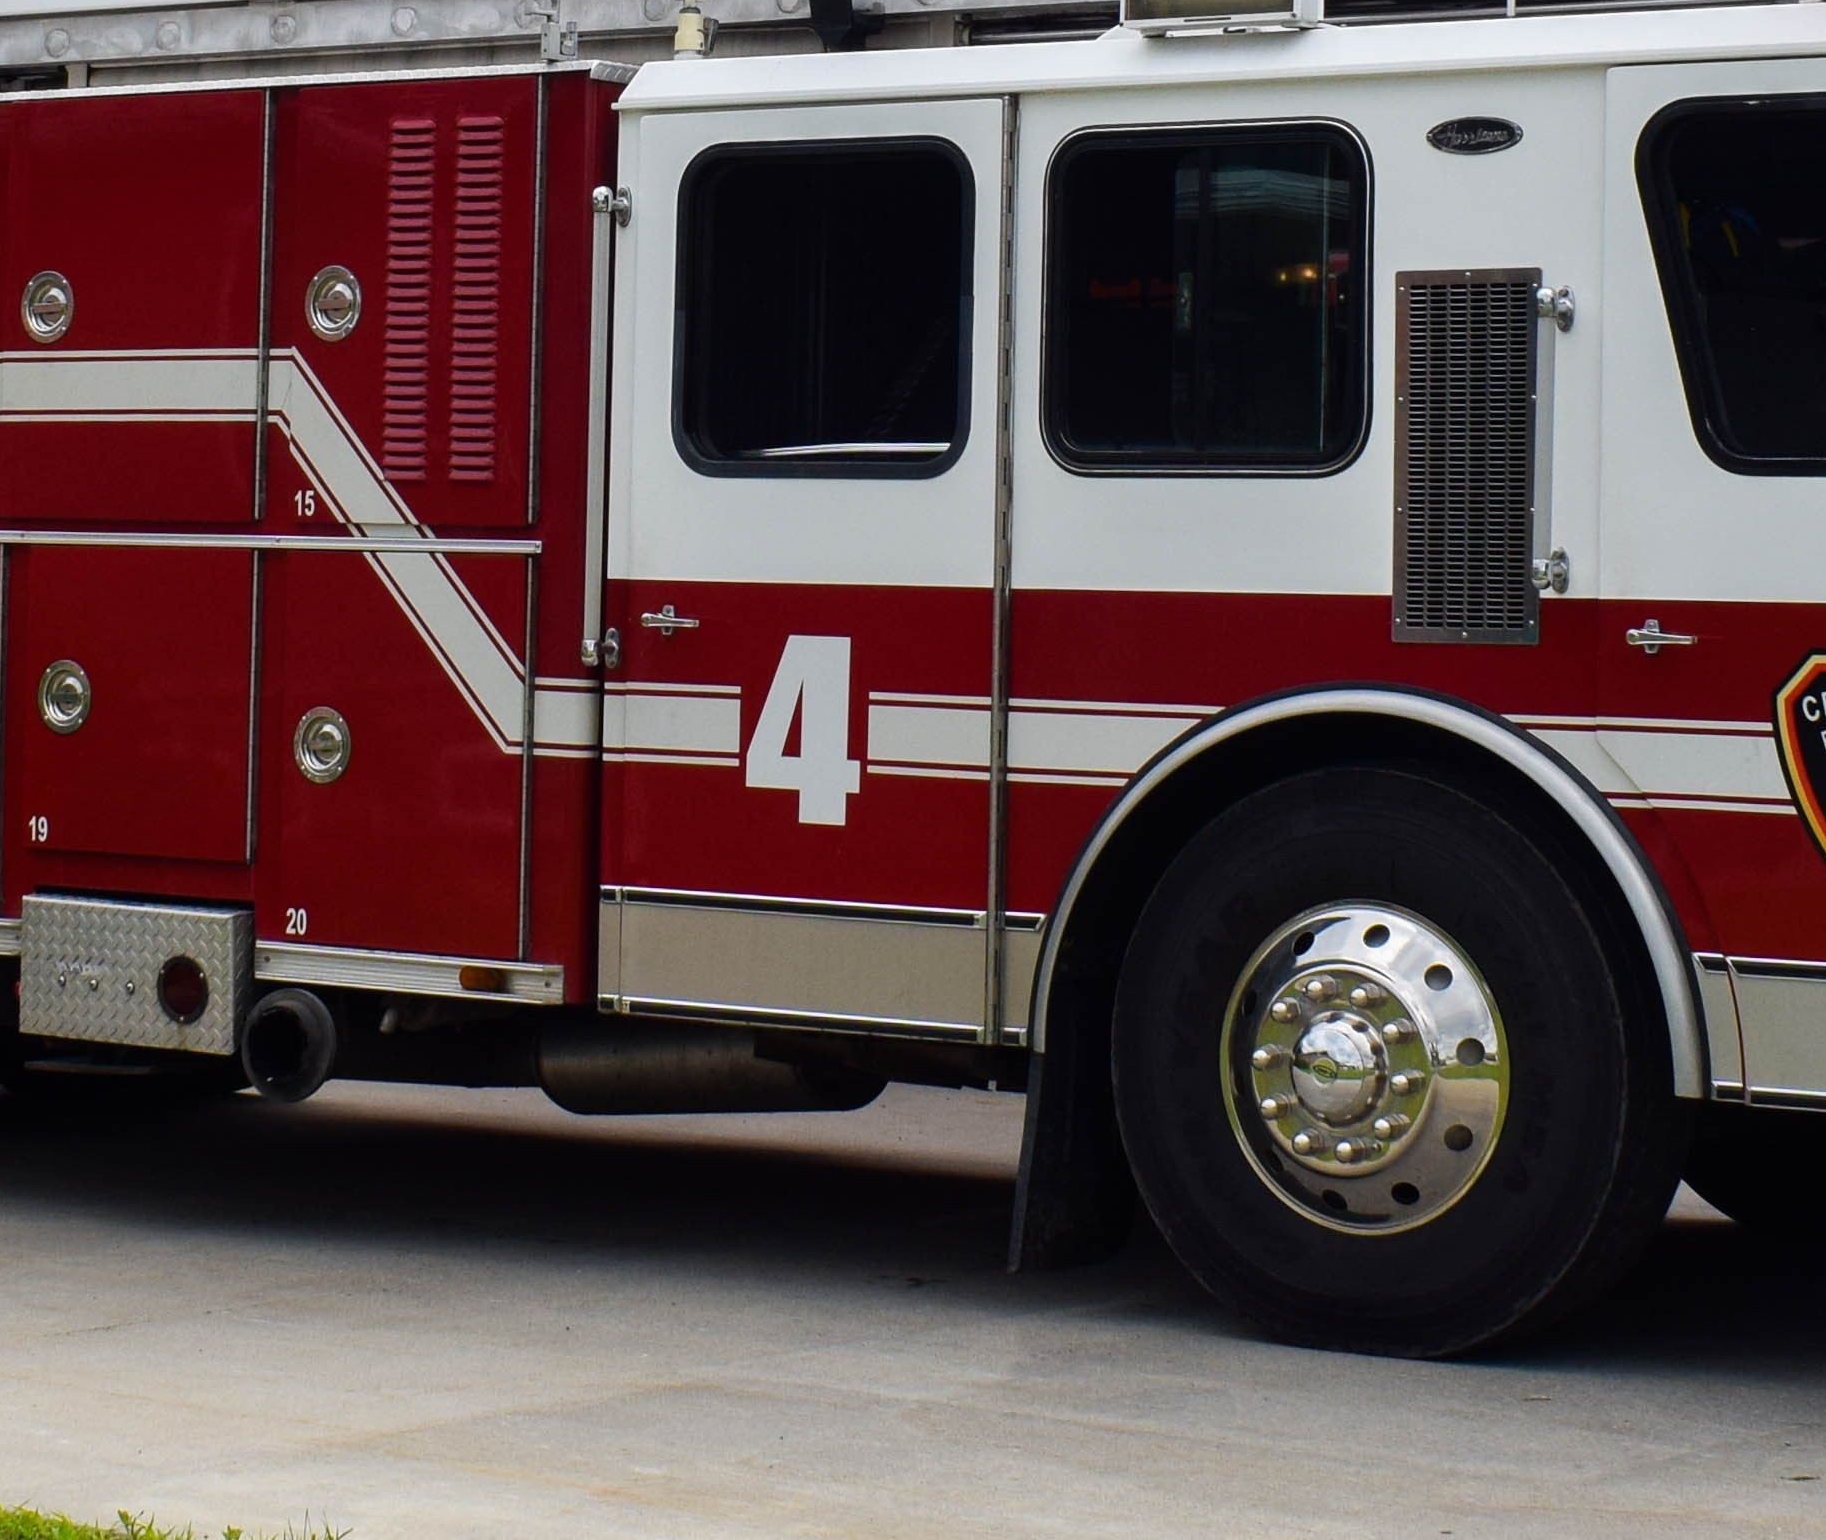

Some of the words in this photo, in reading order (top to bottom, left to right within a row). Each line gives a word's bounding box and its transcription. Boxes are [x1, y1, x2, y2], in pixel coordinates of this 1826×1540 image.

[295, 490, 315, 516] 15
[745, 634, 861, 826] 4
[29, 816, 48, 842] 19
[286, 908, 307, 935] 20
